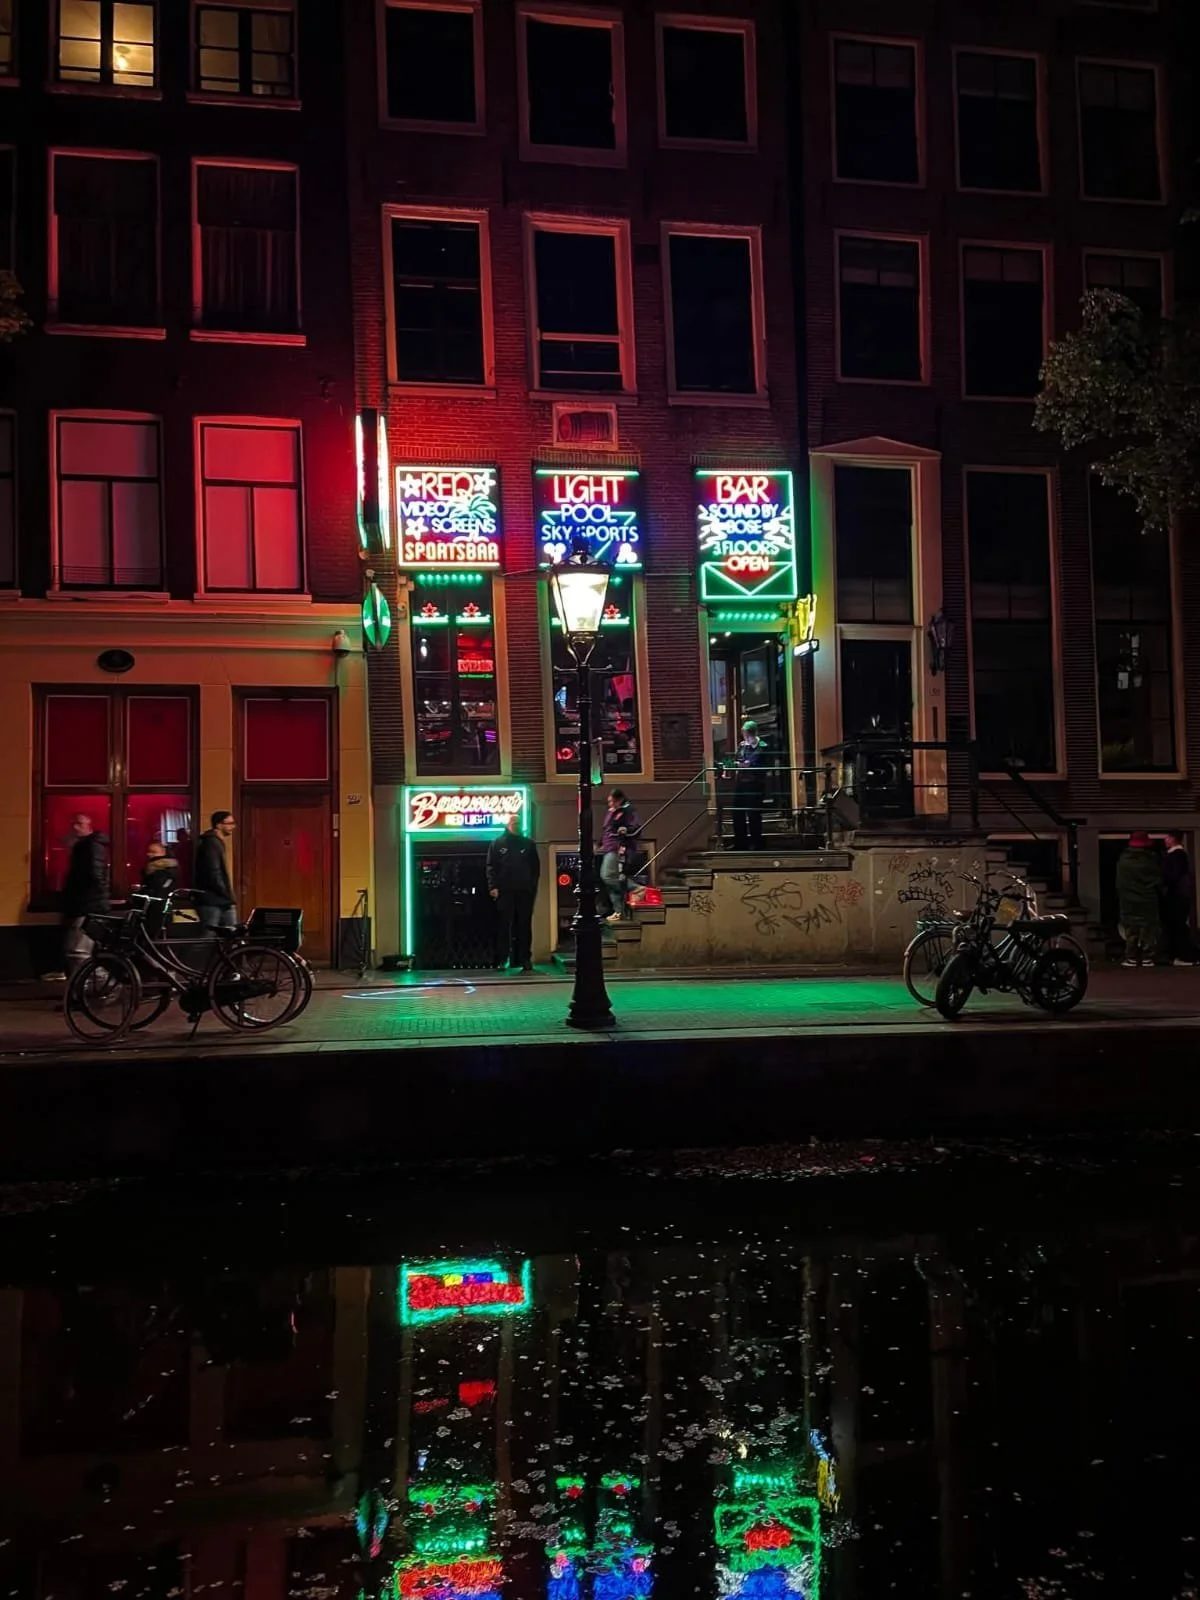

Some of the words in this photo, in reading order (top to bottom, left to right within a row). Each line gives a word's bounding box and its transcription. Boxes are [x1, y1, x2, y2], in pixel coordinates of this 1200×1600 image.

[553, 474, 625, 503] LIGHT
[716, 475, 770, 503] BAR
[401, 501, 450, 517] VIDEO
[560, 503, 618, 523] POOL
[708, 503, 760, 519] SOUND
[761, 503, 779, 518] BY
[431, 517, 497, 533] SCREENS
[541, 524, 572, 541] SKY
[726, 519, 763, 534] BOSE
[404, 541, 499, 561] SPORTSBAR
[722, 540, 780, 556] FLOORS
[727, 555, 770, 572] OPEN
